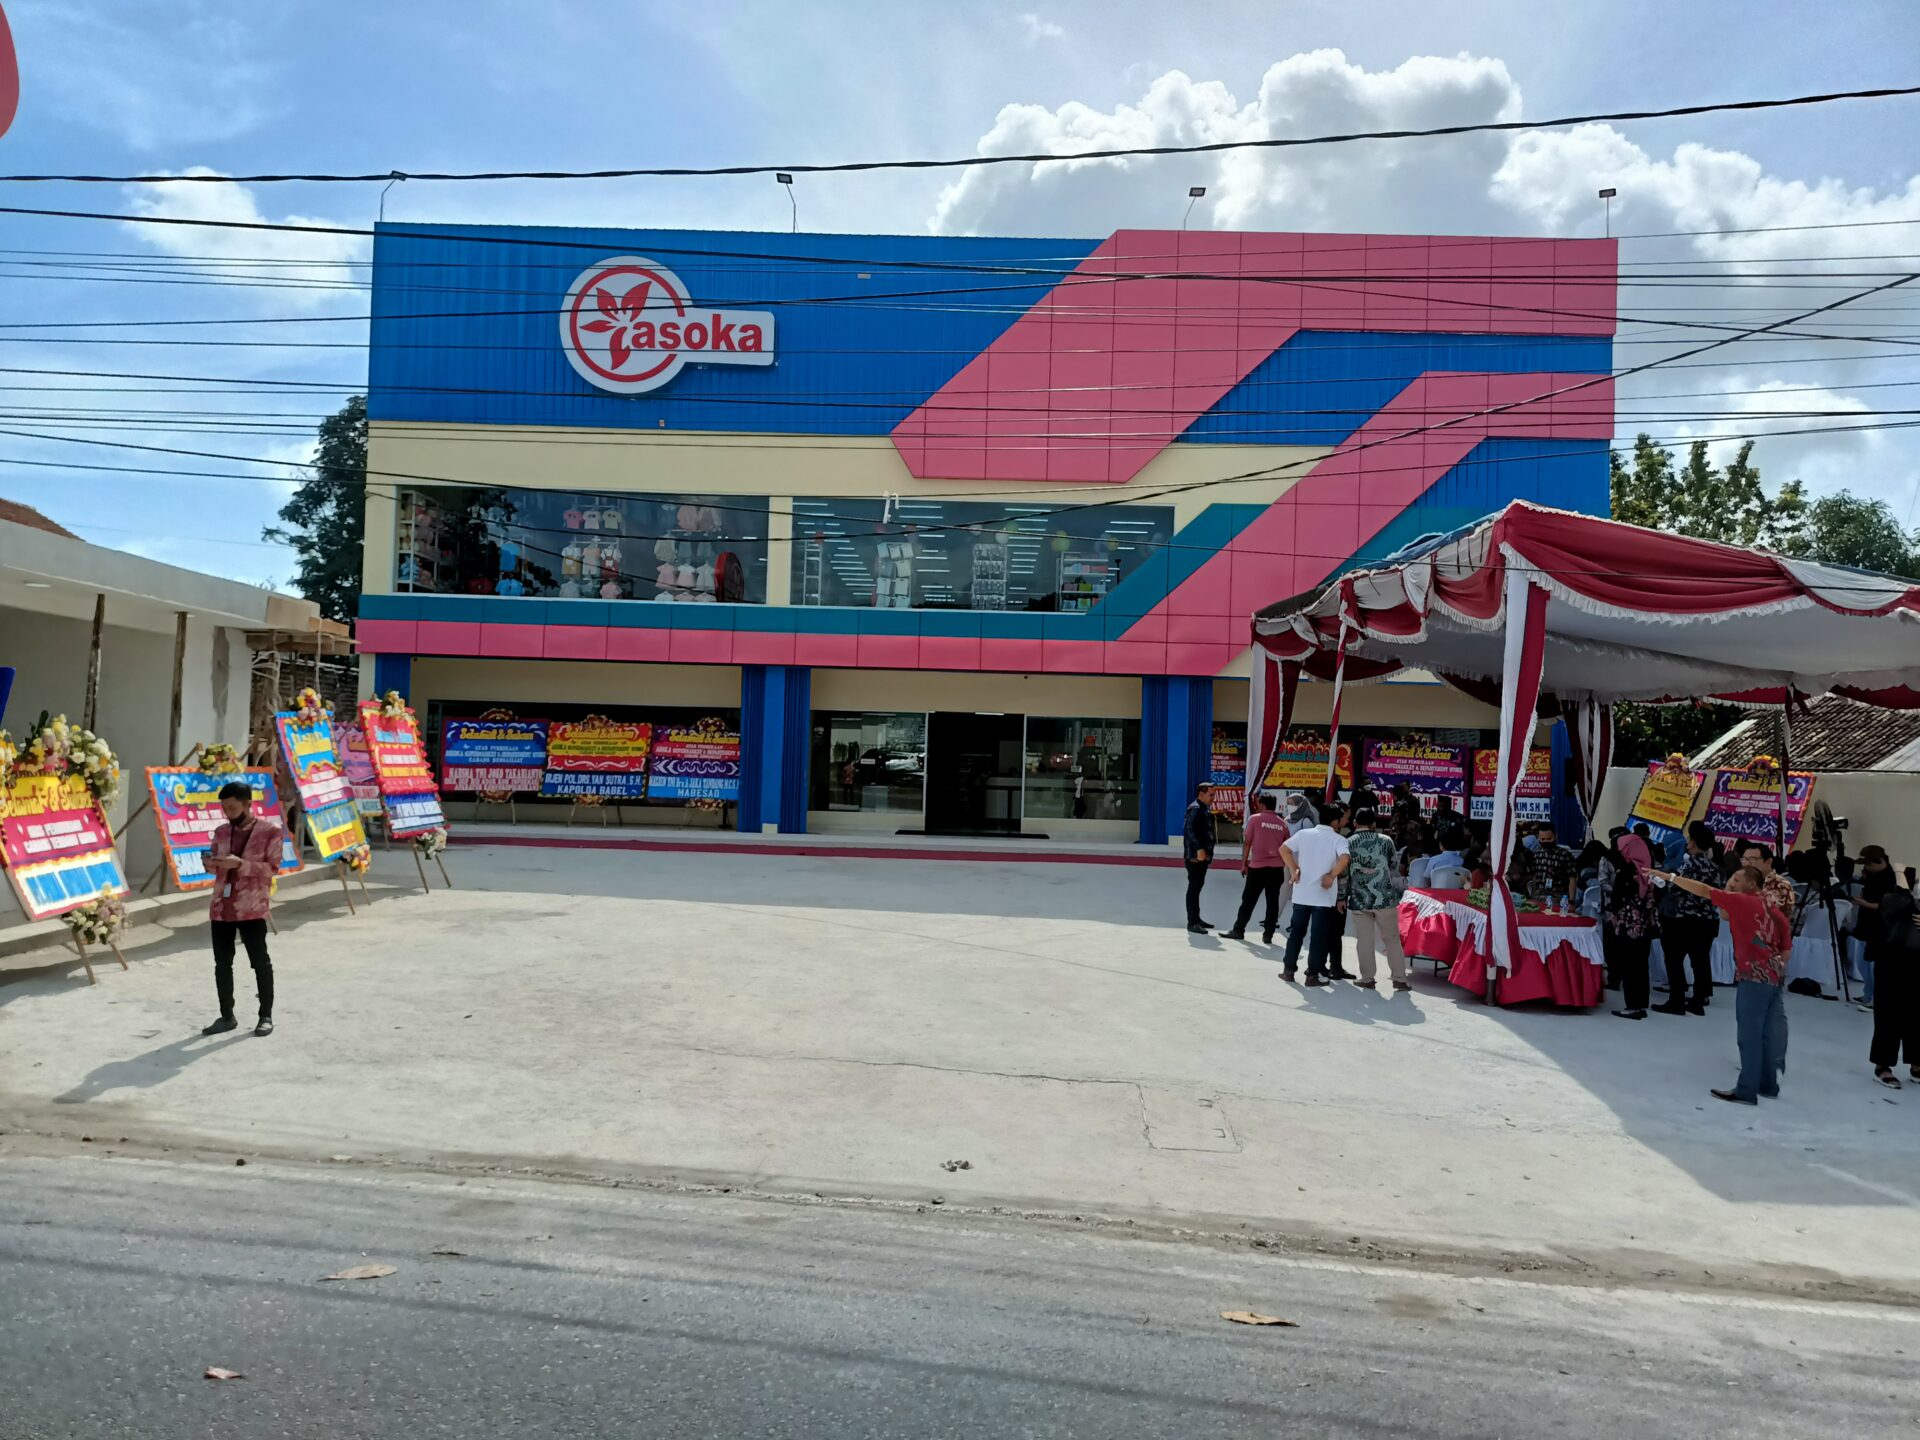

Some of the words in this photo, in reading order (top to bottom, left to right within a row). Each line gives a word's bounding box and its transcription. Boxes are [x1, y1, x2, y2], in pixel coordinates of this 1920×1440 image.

[631, 313, 763, 352] asoka
[1380, 744, 1415, 758] Selamat
[1423, 746, 1451, 760] Sukses
[600, 786, 628, 796] BABEL
